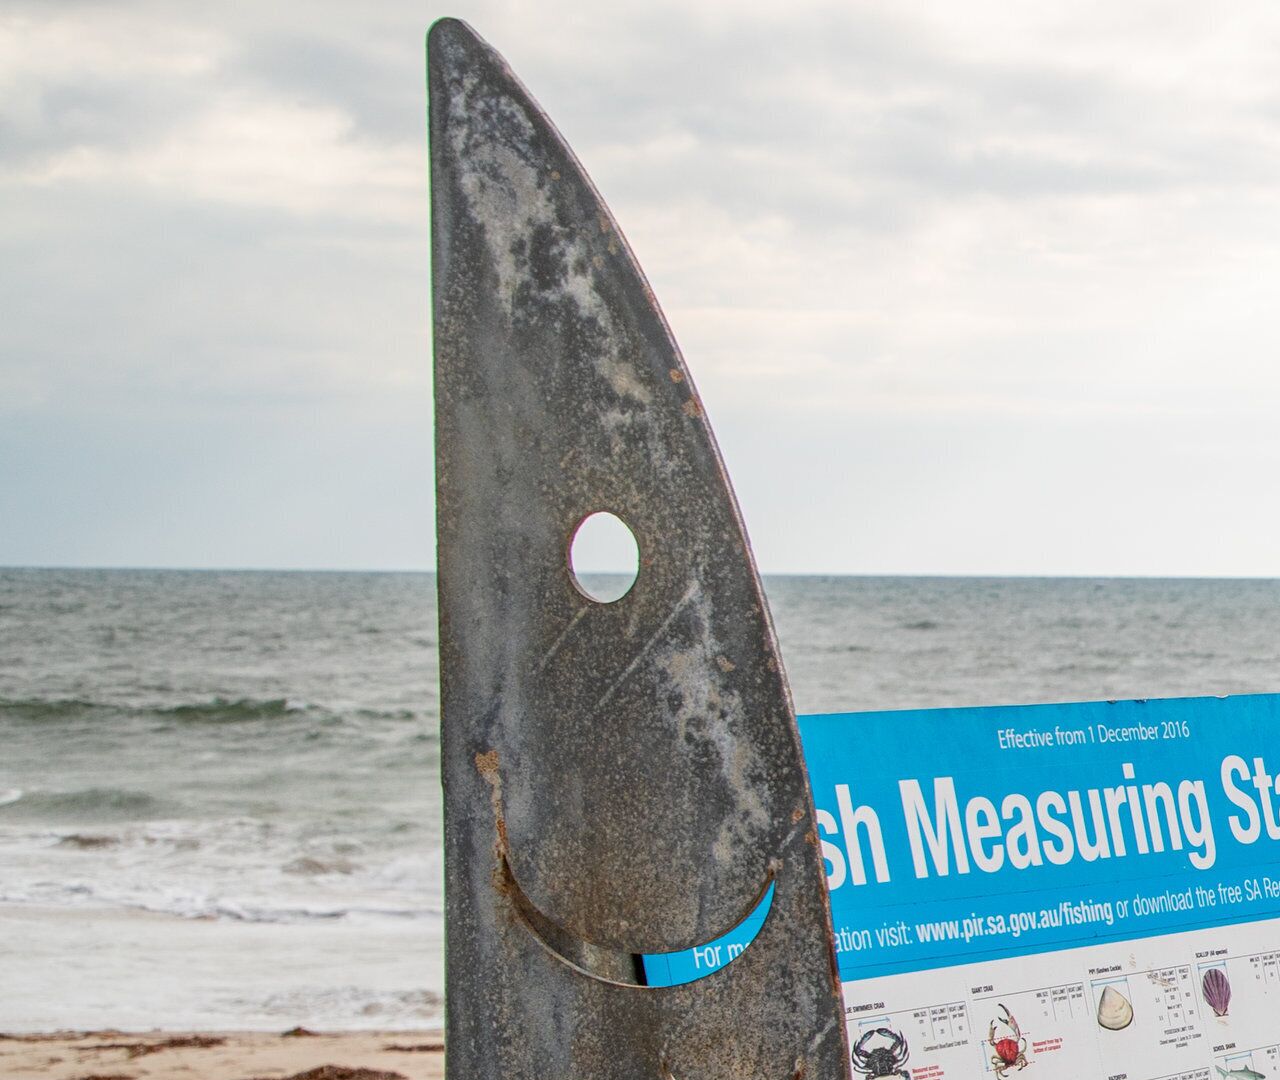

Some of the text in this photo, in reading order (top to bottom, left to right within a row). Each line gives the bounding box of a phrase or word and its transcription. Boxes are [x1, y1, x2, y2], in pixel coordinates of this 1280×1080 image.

[998, 721, 1190, 750] Effective from 1 December 2016
[898, 762, 1217, 871] Measuring
[875, 922, 914, 947] visit:
[916, 900, 1114, 943] www.pir.sa.gov.au/fishing
[1116, 900, 1129, 919] or
[1133, 892, 1194, 917] download
[1195, 888, 1216, 908] the
[1217, 882, 1242, 904] free
[1244, 880, 1263, 901] SA
